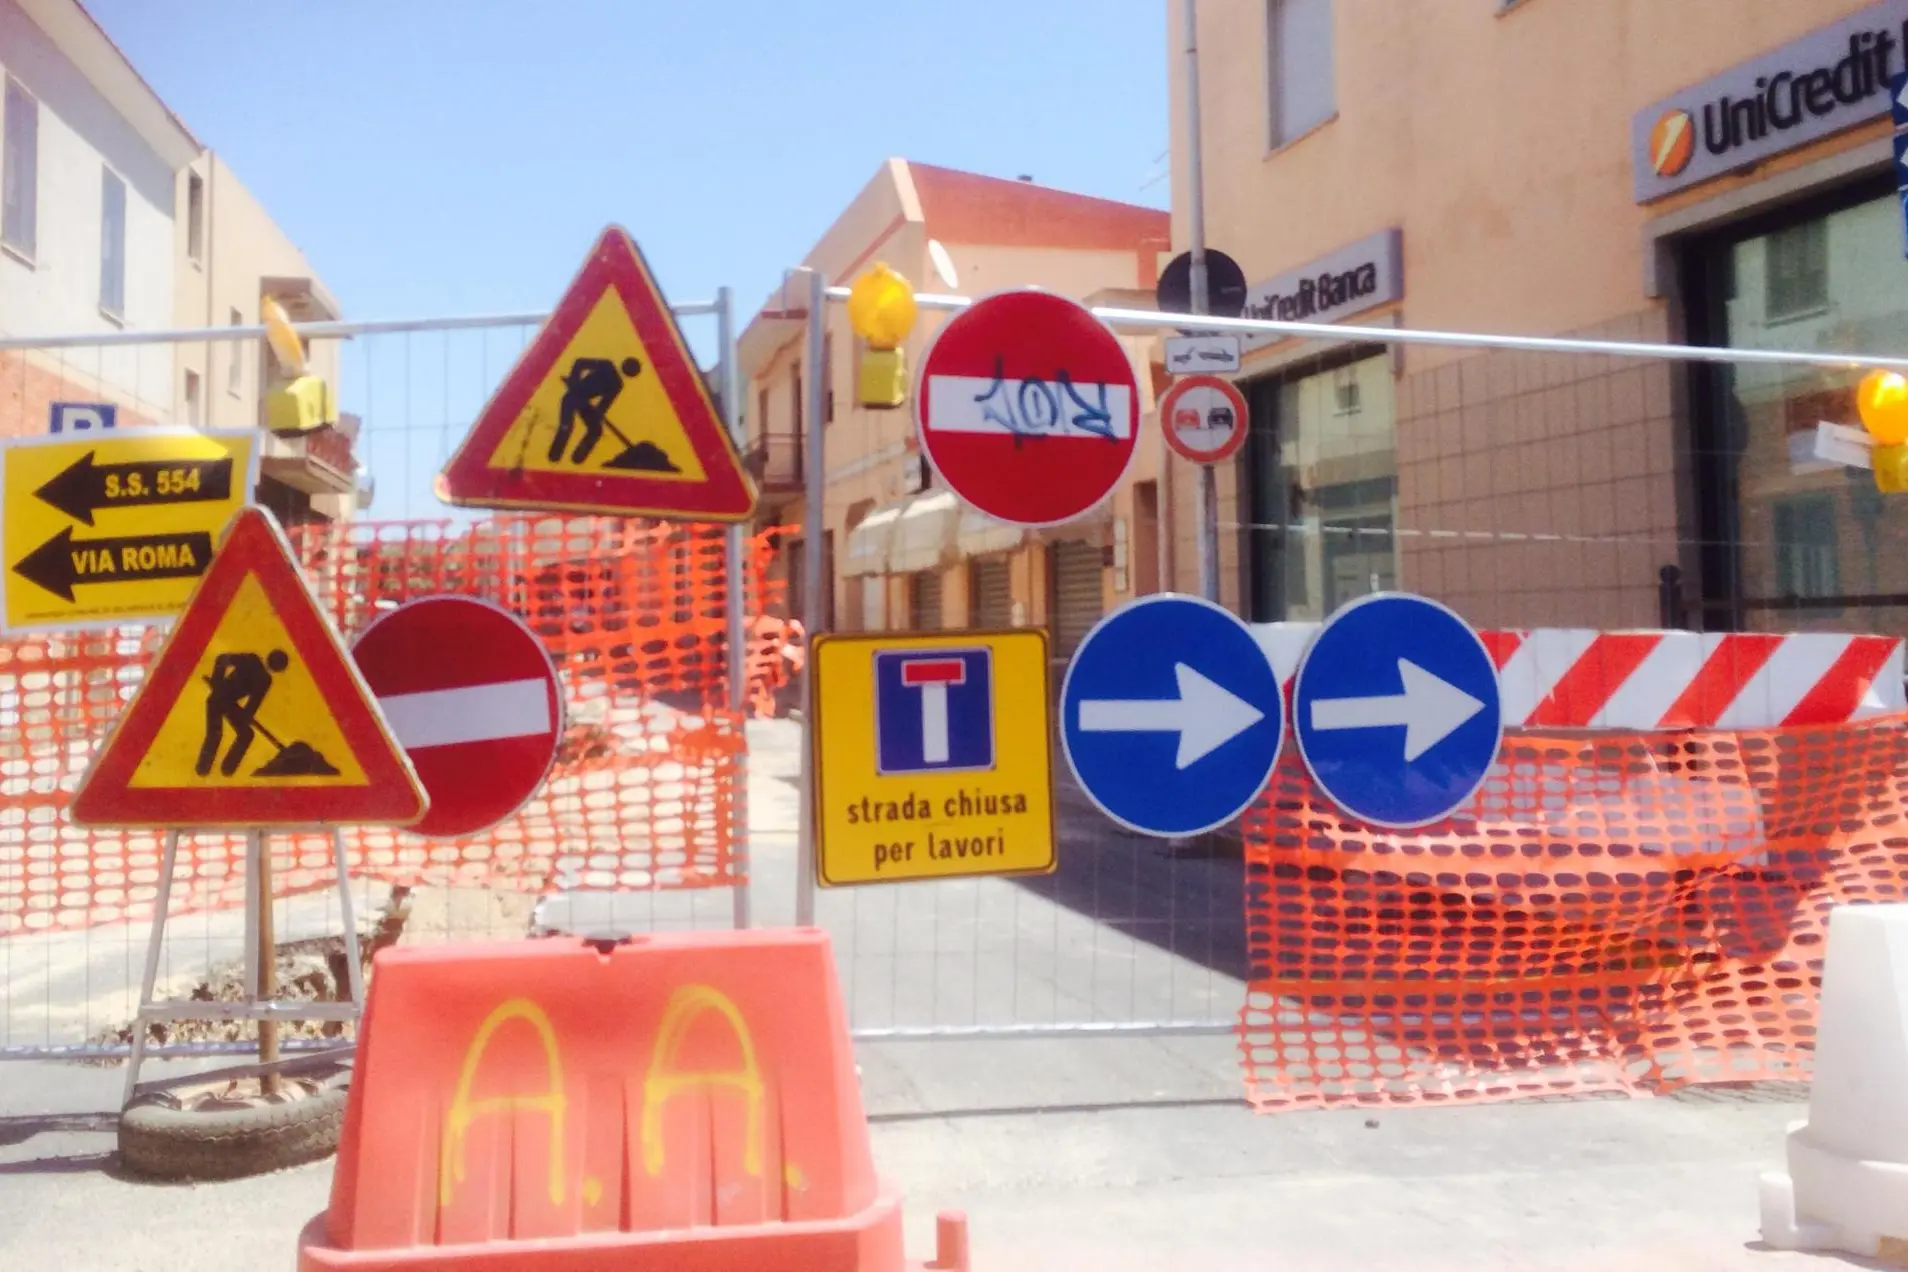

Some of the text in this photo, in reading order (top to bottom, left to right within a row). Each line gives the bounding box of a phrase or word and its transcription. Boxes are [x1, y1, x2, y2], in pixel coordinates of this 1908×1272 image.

[1703, 30, 1895, 155] UniCredit
[1317, 261, 1377, 312] Banca
[104, 467, 201, 499] S.S. 554
[71, 543, 196, 575] VIA ROMA
[847, 787, 1027, 824] strada chiusa
[874, 828, 1004, 871] per lavori
